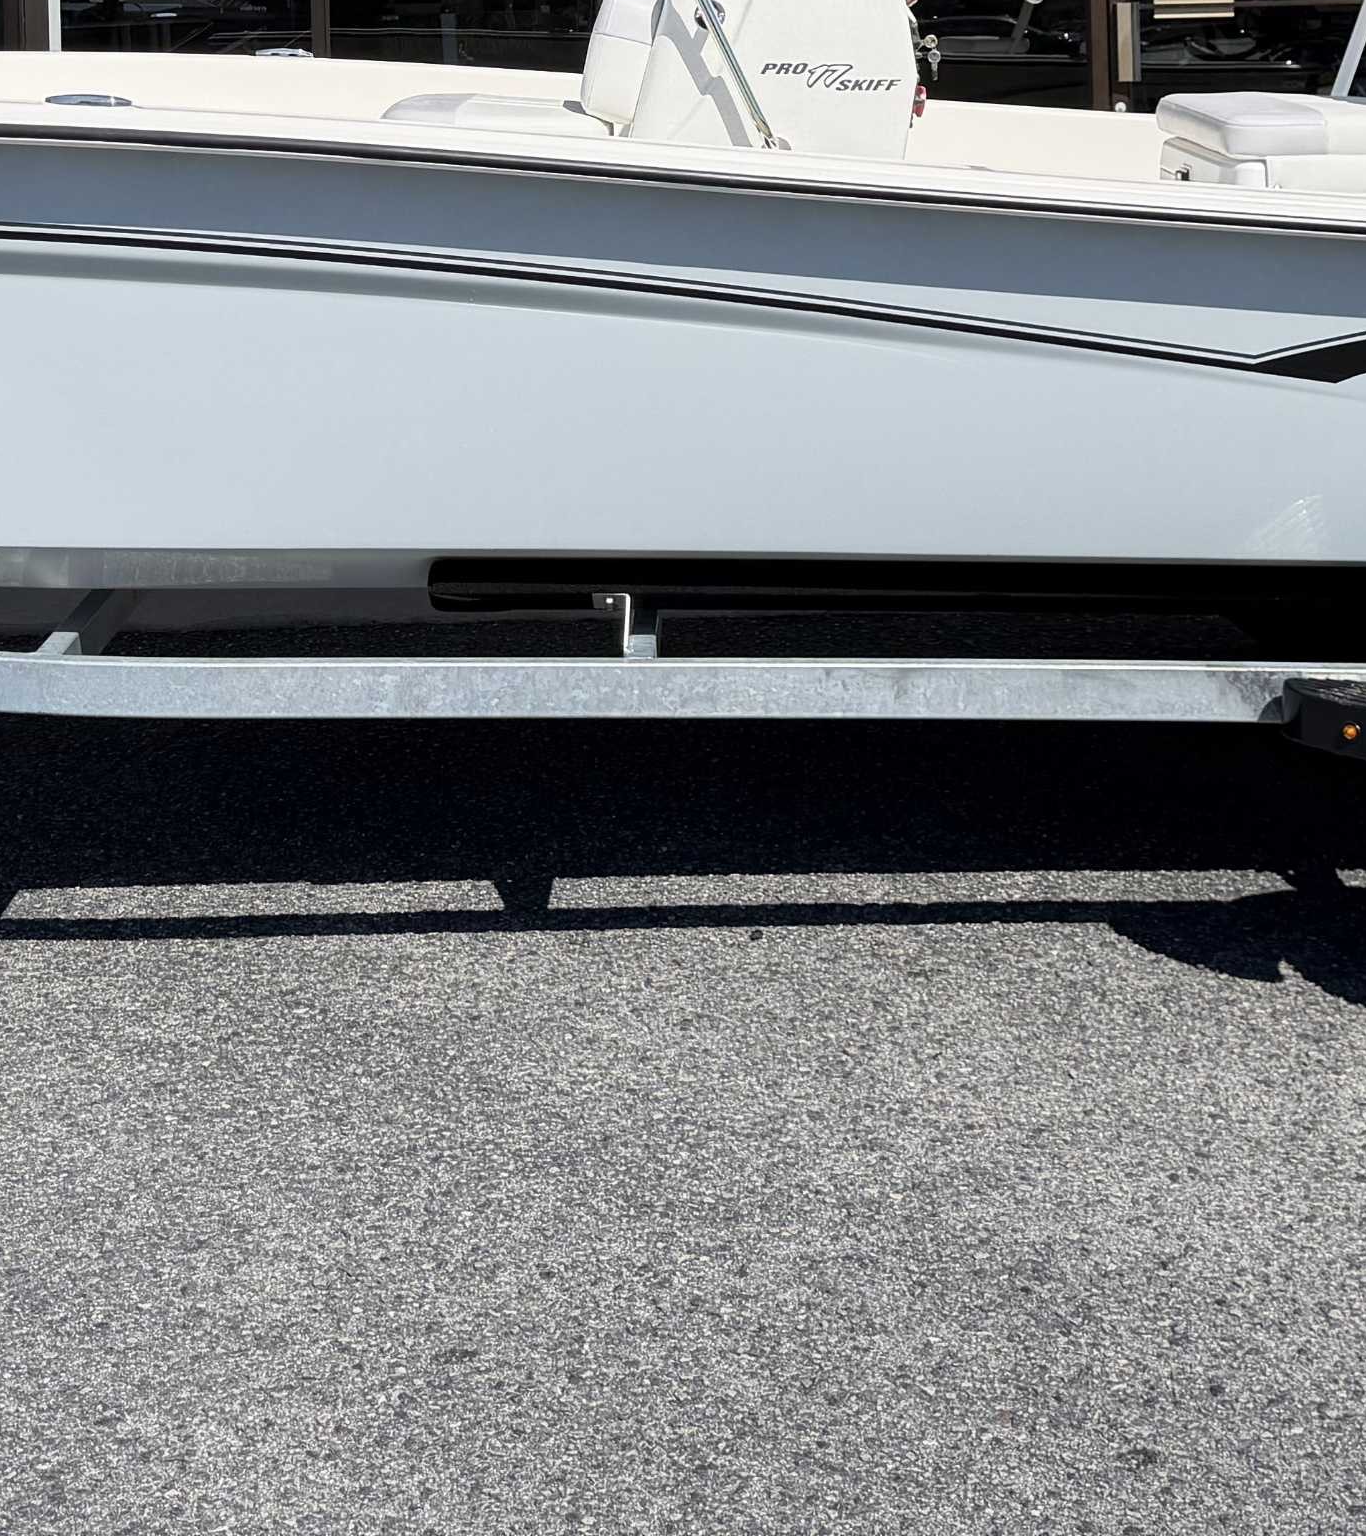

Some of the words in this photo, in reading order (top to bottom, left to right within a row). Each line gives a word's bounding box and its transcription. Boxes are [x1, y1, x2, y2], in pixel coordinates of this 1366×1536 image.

[760, 62, 808, 76] PRO
[806, 63, 854, 89] 17
[835, 79, 901, 91] SKIFF
